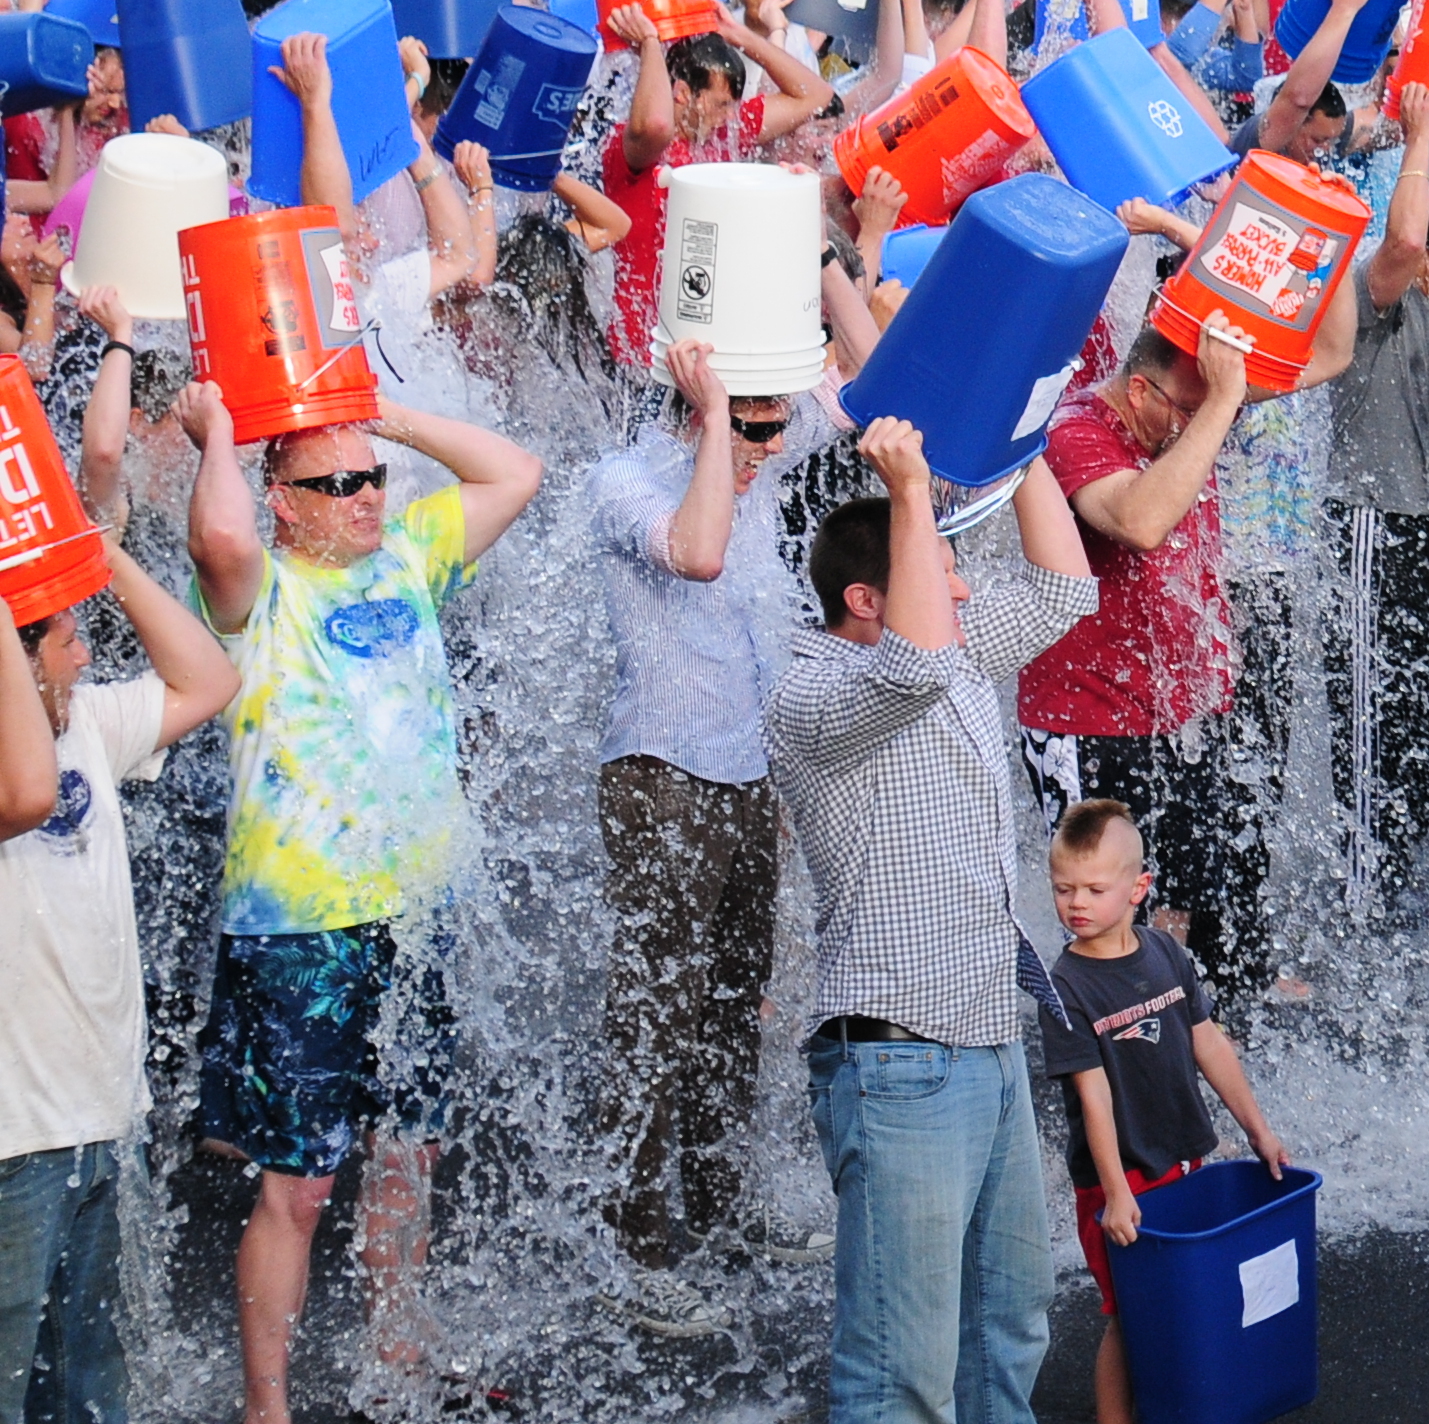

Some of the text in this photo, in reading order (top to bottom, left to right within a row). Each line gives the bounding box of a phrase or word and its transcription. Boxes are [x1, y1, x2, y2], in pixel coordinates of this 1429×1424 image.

[1239, 223, 1287, 257] BUCKET
[0, 502, 54, 550] LET
[1144, 985, 1186, 1015] FOOTBAL
